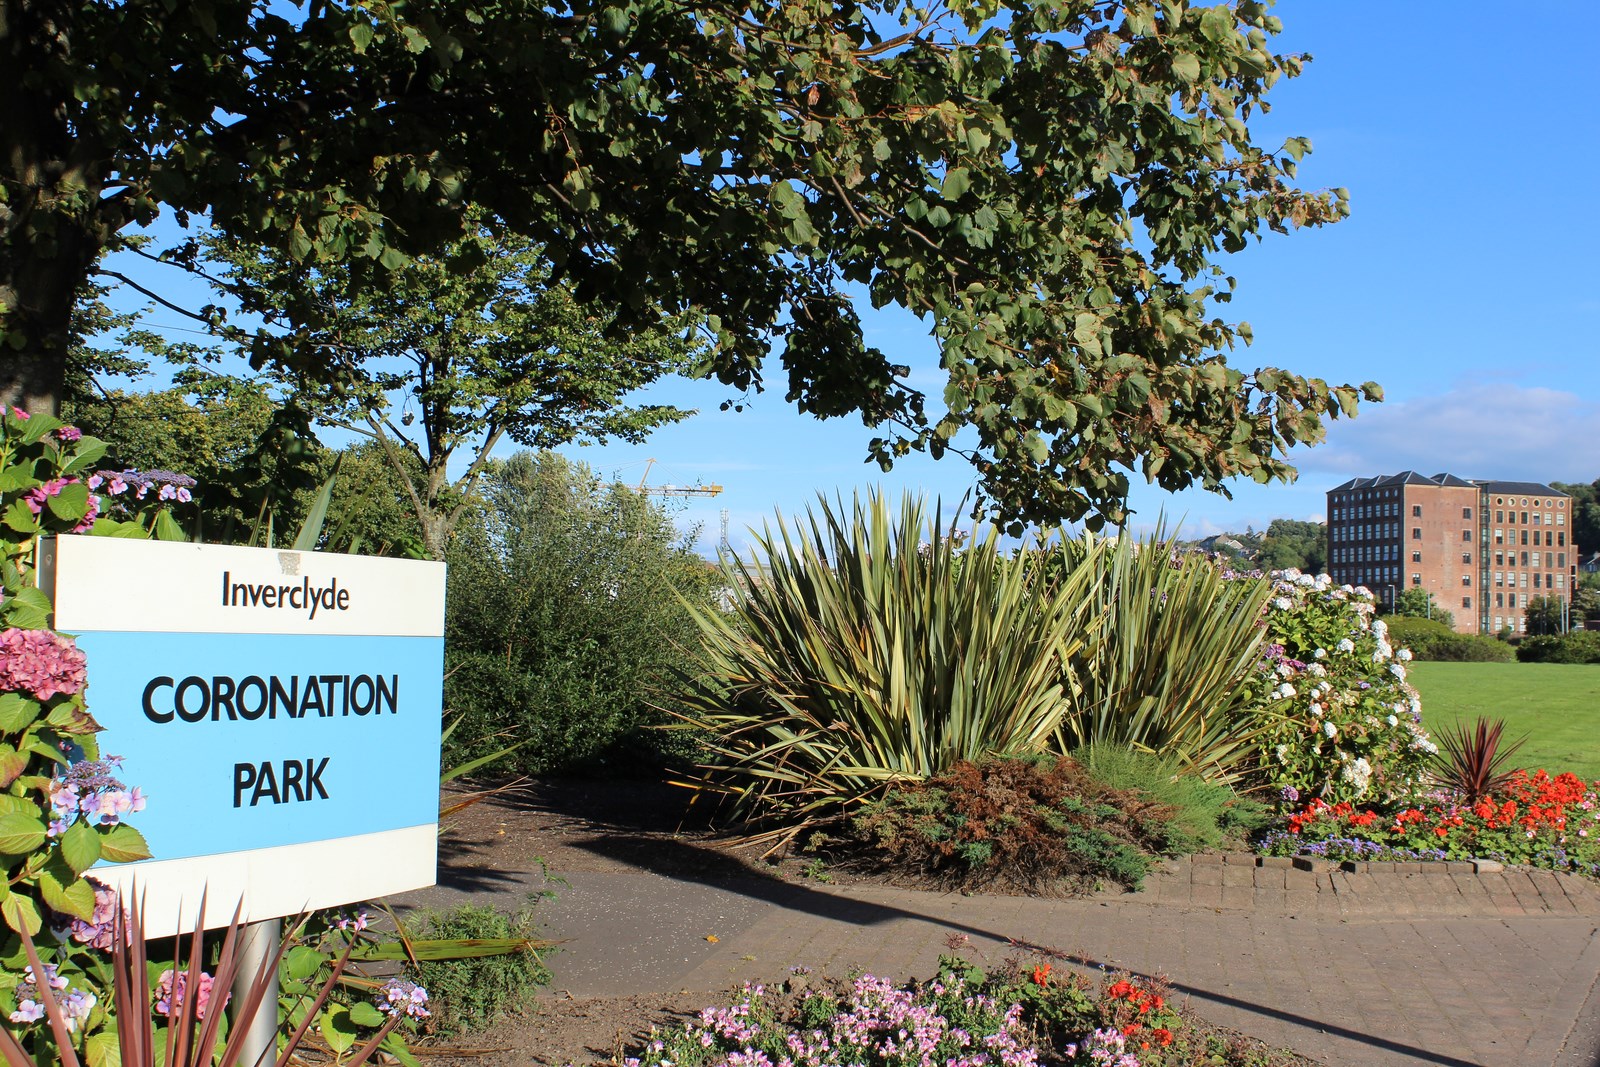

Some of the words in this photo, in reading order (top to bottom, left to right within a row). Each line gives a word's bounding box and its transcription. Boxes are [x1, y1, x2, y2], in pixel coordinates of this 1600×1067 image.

[222, 571, 349, 620] Inverclyde
[142, 674, 398, 724] CORONATION
[233, 757, 330, 808] PARK
